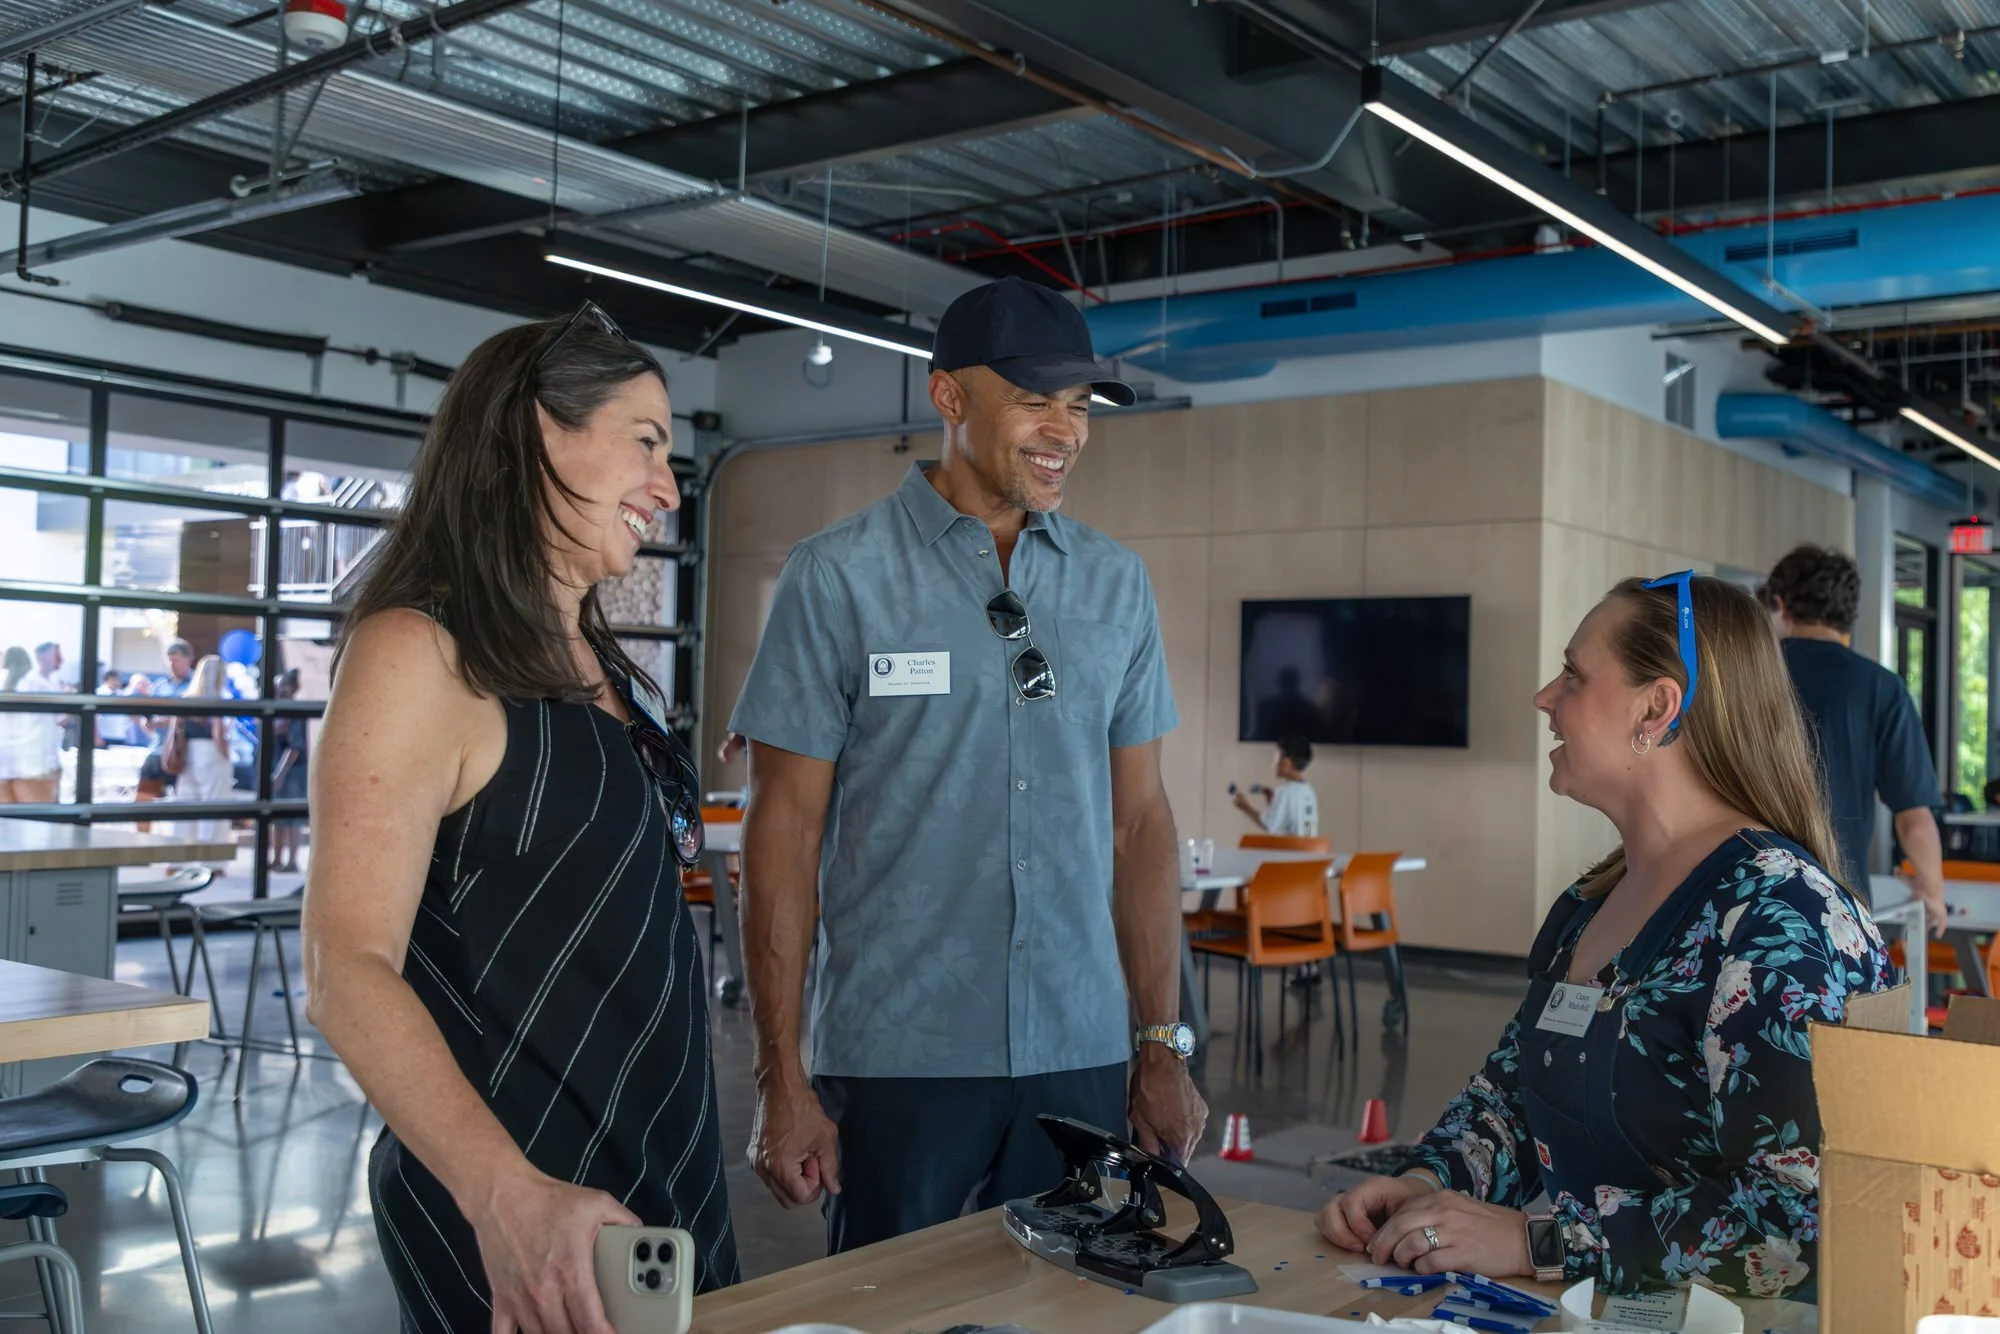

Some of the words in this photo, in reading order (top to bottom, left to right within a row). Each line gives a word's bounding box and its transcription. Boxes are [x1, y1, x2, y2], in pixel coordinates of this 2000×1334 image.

[1953, 526, 1985, 552] EXIT
[907, 658, 936, 667] Charles
[909, 667, 934, 675] Patton
